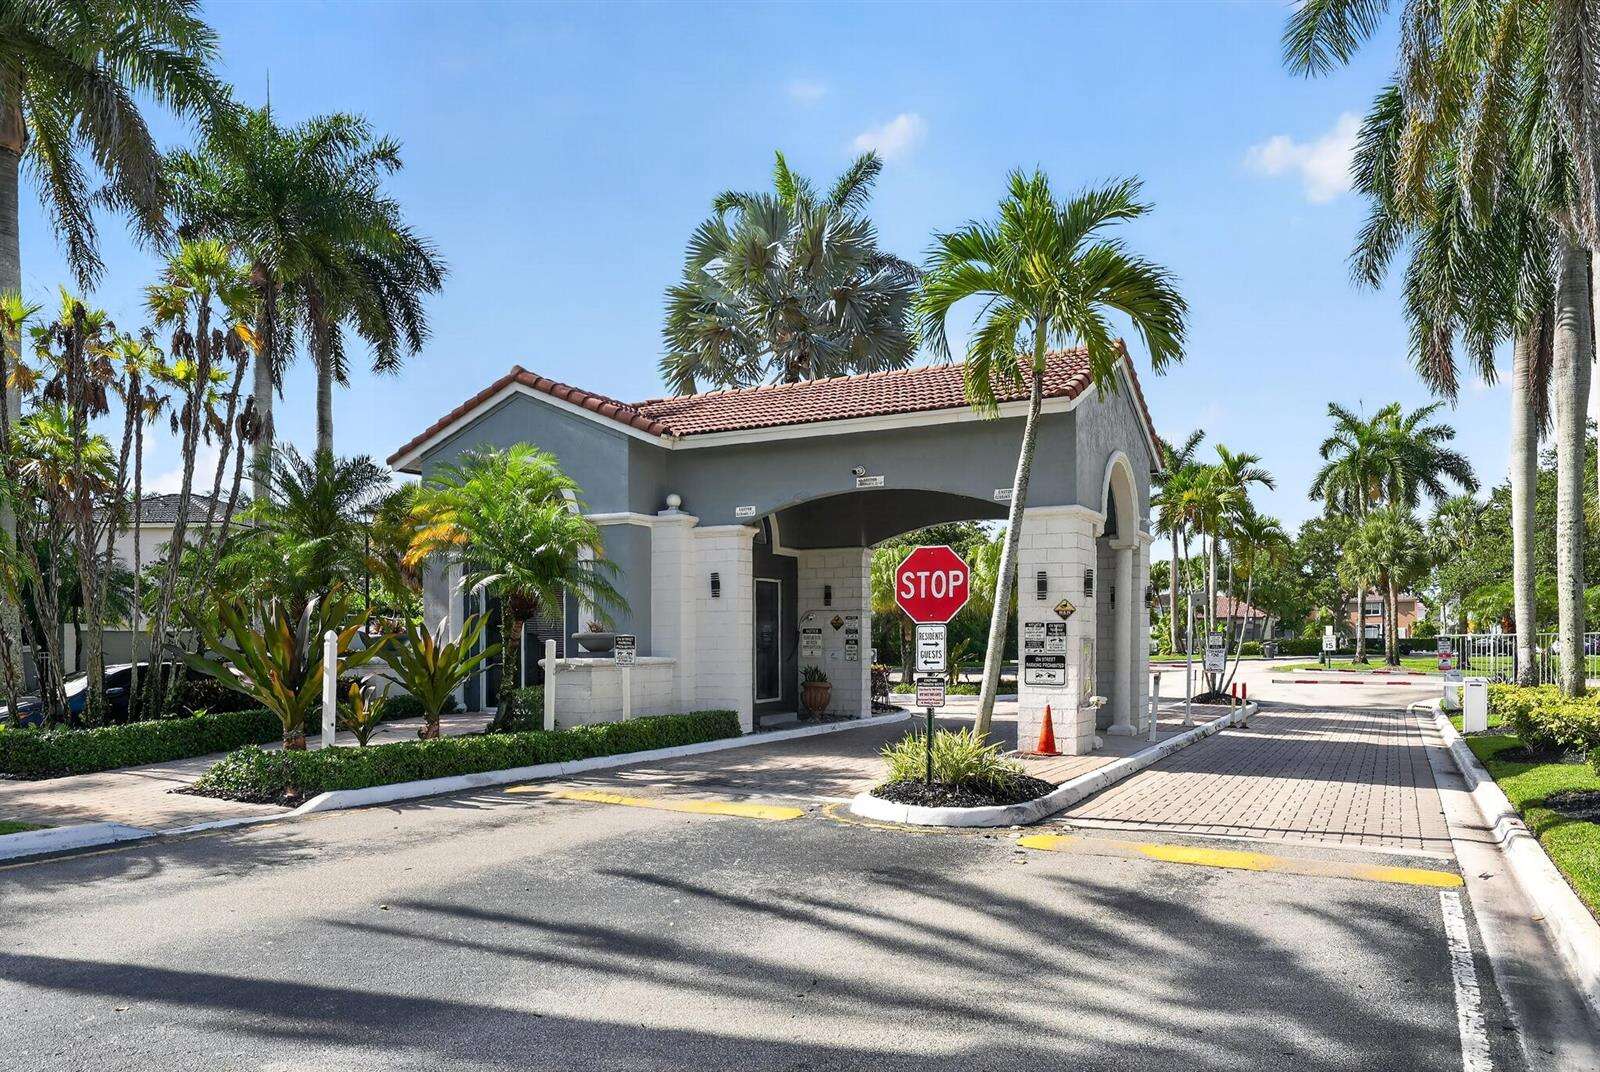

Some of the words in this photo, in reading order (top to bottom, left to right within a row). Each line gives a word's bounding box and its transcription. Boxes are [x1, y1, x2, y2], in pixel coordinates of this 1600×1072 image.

[900, 570, 964, 599] STOP
[918, 631, 944, 640] RESIDENTS
[920, 650, 943, 659] GUESTS
